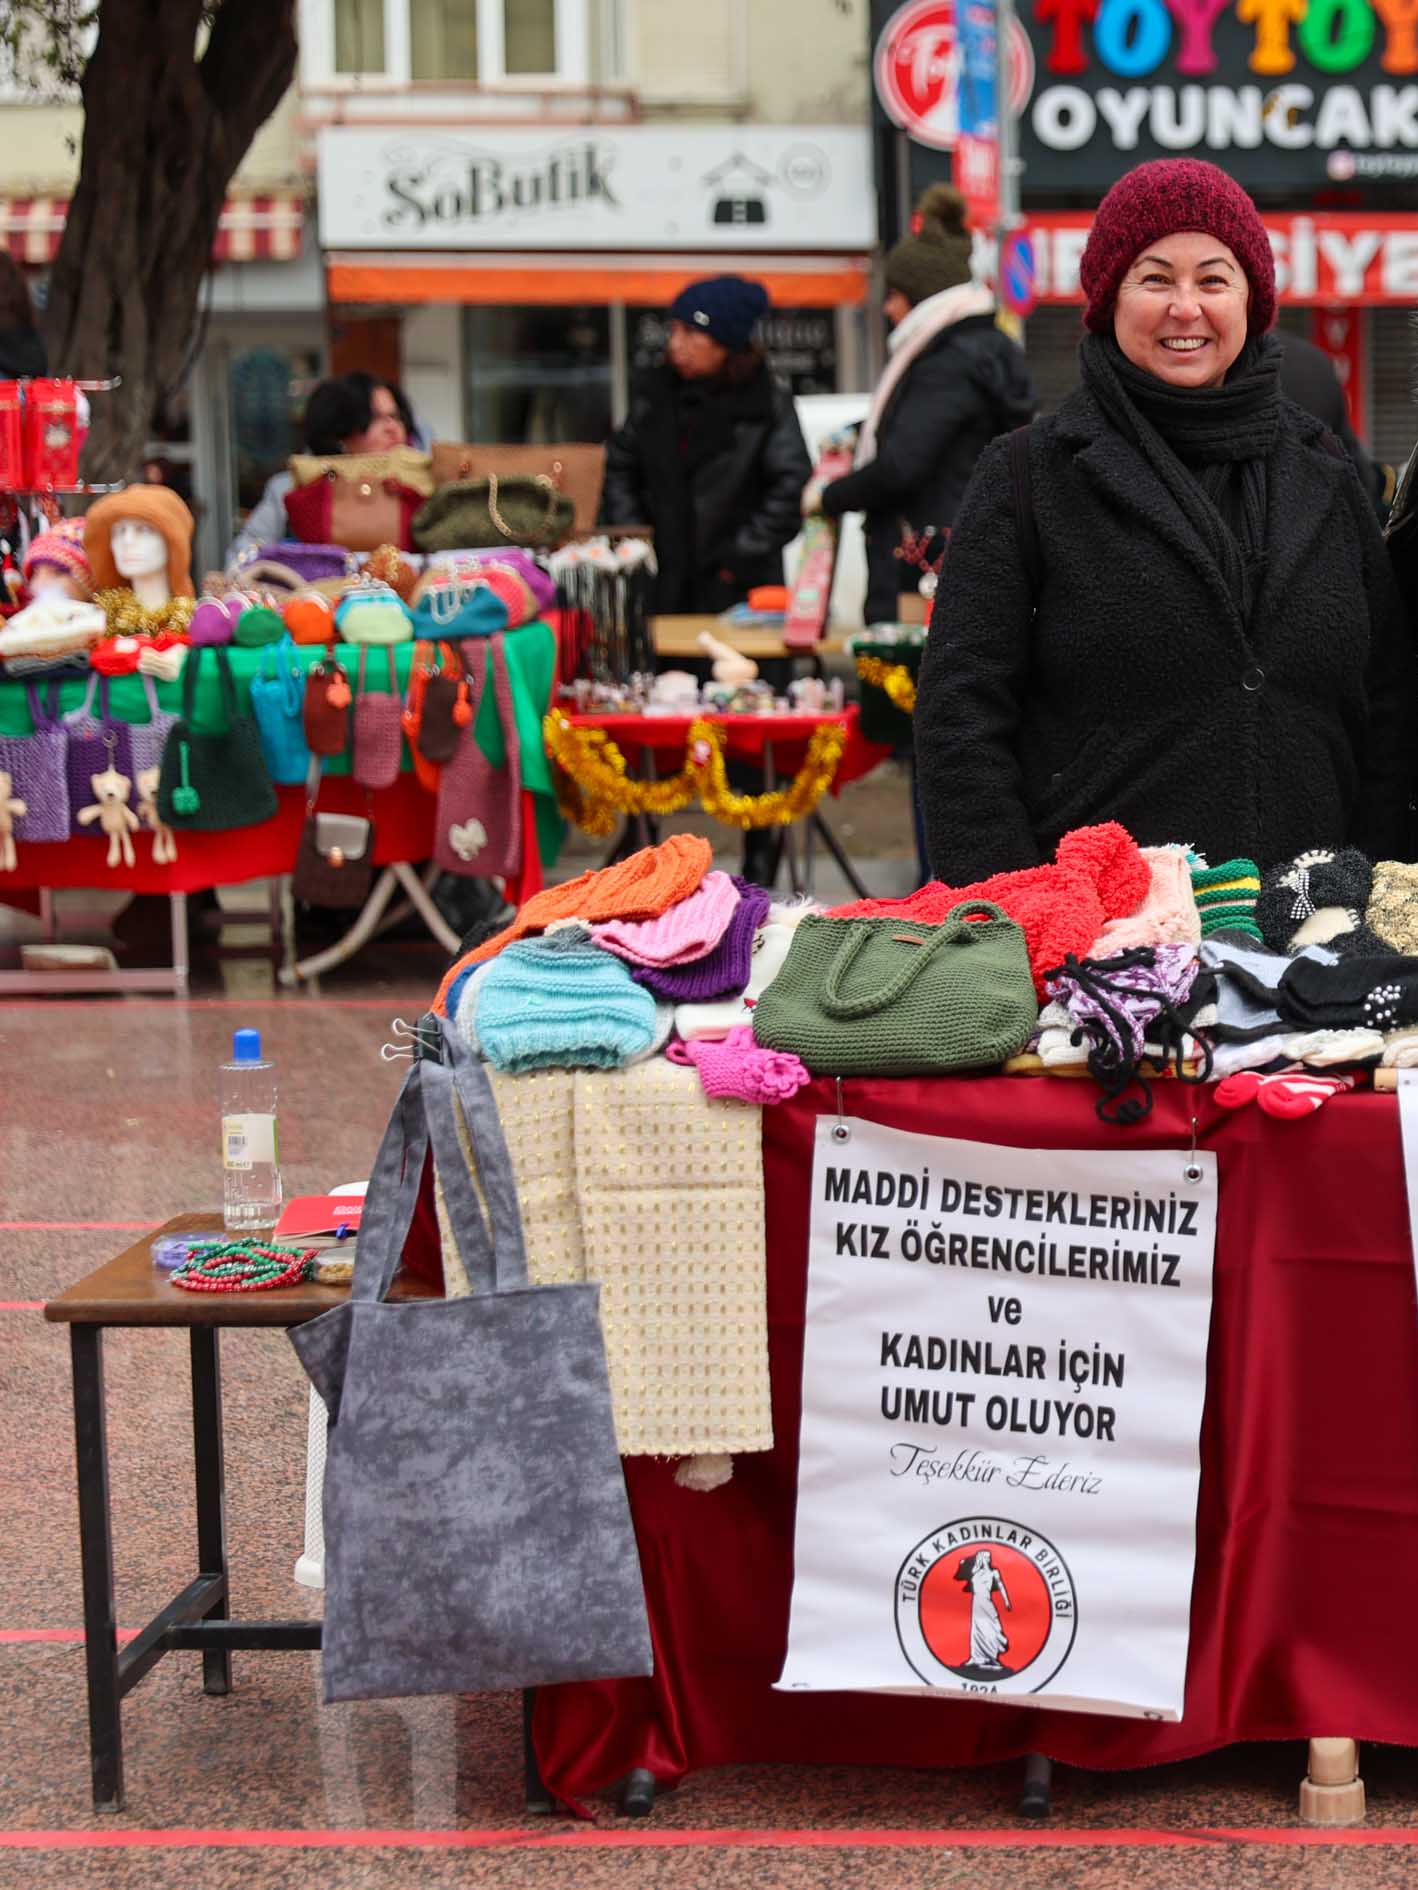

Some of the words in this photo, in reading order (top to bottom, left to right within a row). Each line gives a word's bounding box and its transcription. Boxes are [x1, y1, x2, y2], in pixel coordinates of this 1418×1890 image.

[824, 1167, 929, 1211] MADDİ
[940, 1178, 1199, 1236] DESTEKLERİNİZ
[835, 1222, 890, 1260] KIZ
[900, 1220, 1181, 1287] ÖĞRENCİLERİMİZ
[987, 1295, 1022, 1326] ve
[880, 1332, 1046, 1379] KADINLAR
[1058, 1340, 1125, 1394] İÇİN
[881, 1387, 975, 1427] UMUT
[986, 1396, 1116, 1441] OLUYOR
[890, 1443, 1002, 1485] Teşekkür
[1006, 1456, 1102, 1494] Ederiz
[901, 1554, 931, 1603] TÜRK
[932, 1524, 1033, 1553] KADINLAR
[1034, 1548, 1073, 1619] BİRLİĞİ
